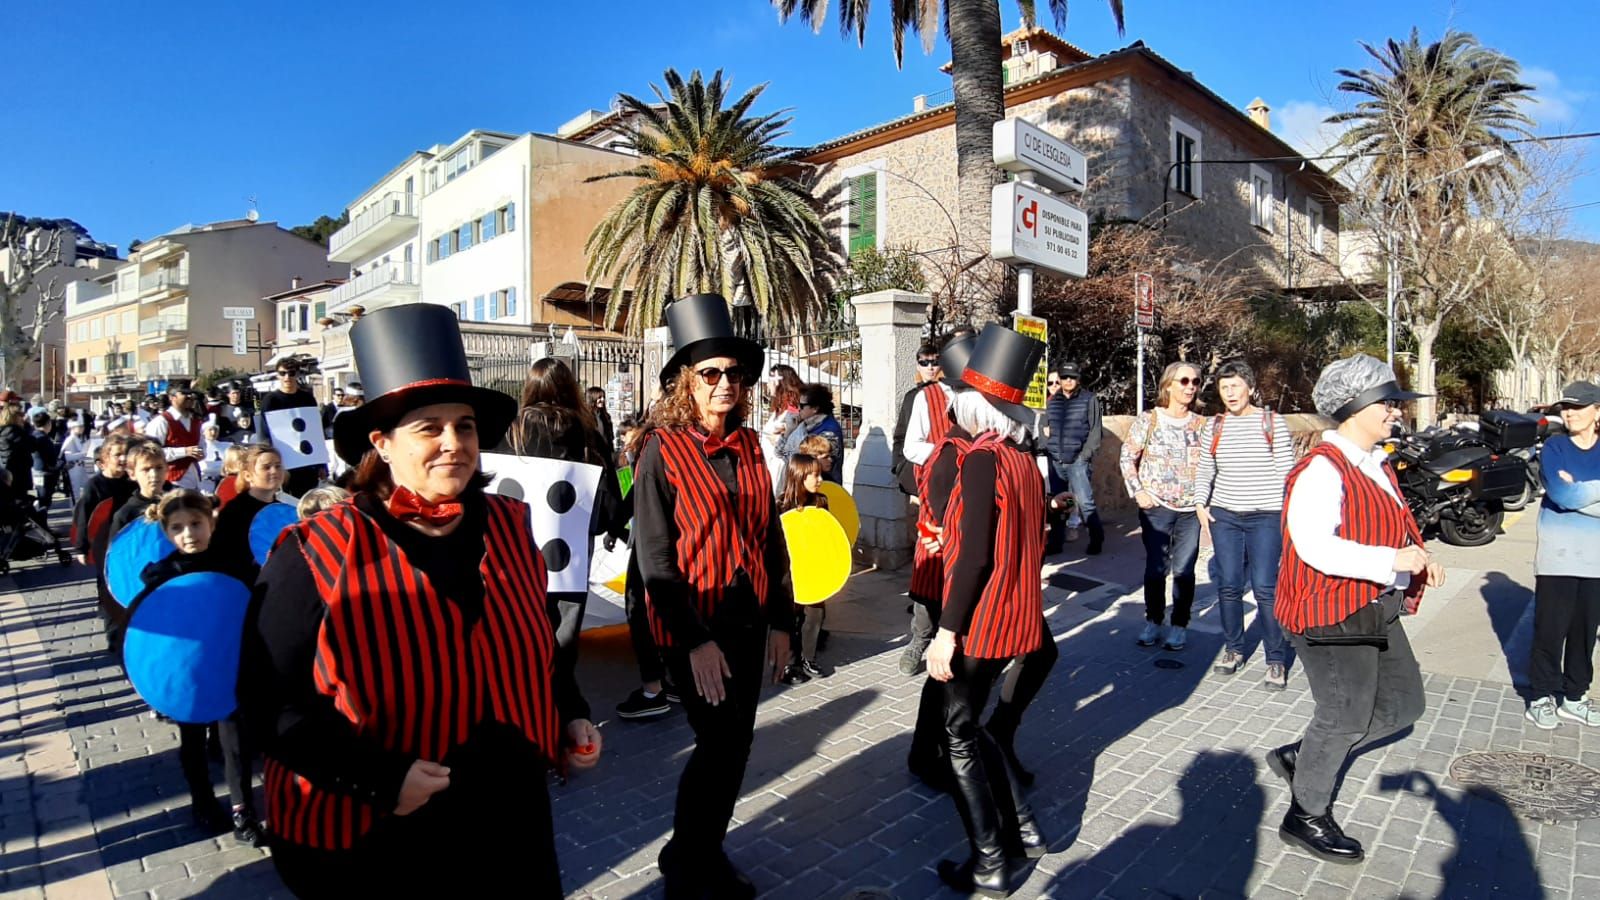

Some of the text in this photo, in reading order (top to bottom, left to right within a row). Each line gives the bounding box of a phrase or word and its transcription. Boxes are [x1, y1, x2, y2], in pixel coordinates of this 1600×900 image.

[1033, 136, 1041, 154] DE
[1042, 209, 1082, 232] DISPONIBLE PARA
[1044, 225, 1052, 236] SU
[1052, 227, 1079, 245] PUBLICIDAD
[235, 320, 244, 352] HOTEL
